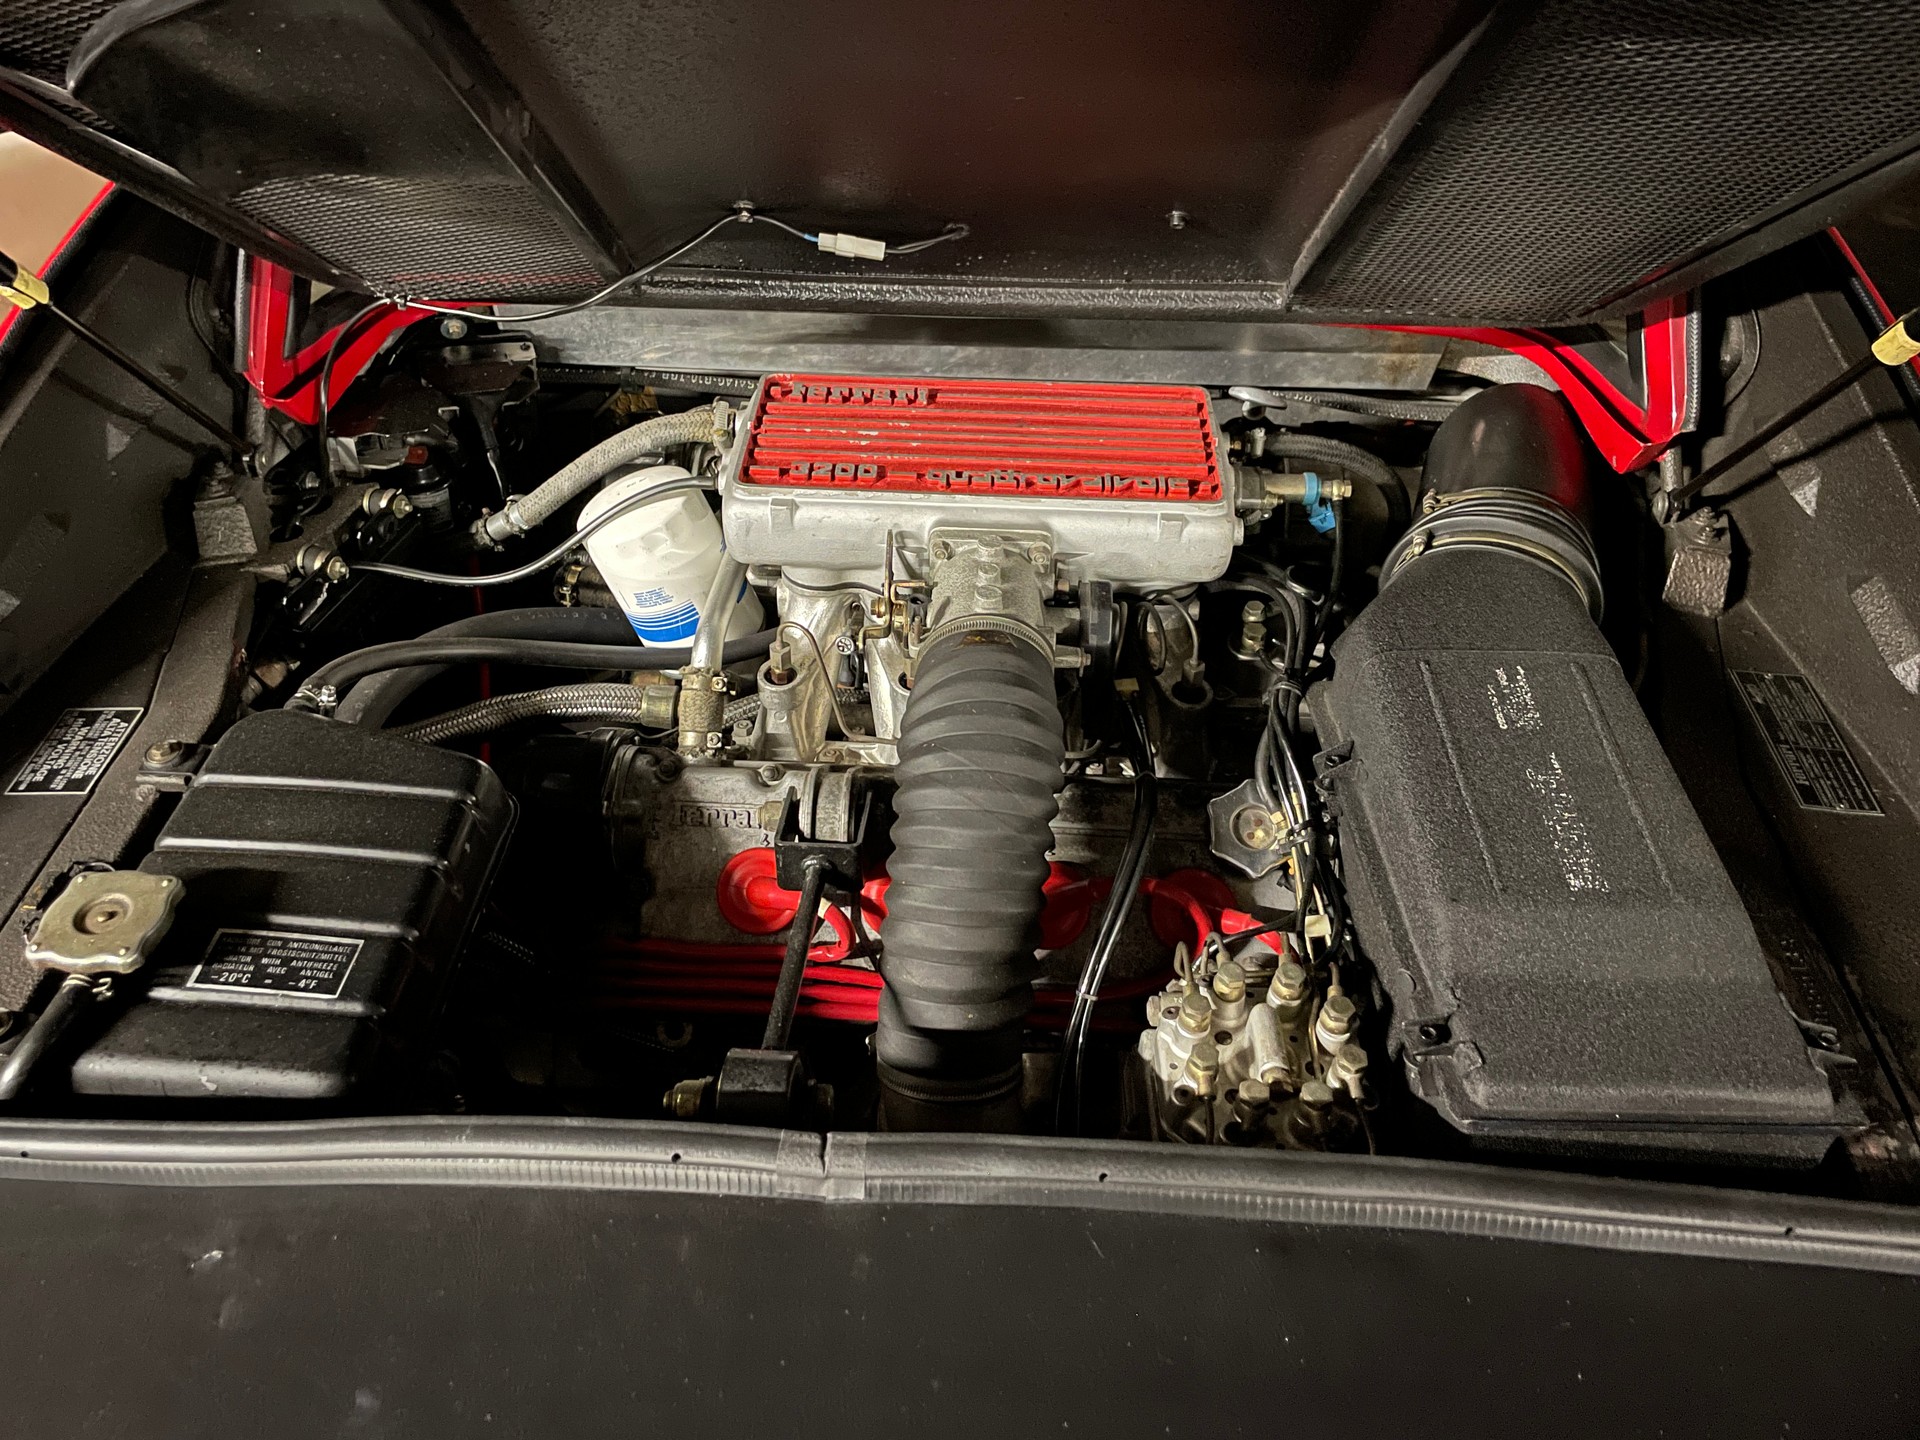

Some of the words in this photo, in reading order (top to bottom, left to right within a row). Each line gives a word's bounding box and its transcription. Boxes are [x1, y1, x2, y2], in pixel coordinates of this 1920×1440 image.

[788, 461, 880, 485] 3200
[926, 469, 1188, 497] quattrovalvole
[61, 718, 86, 740] HIGH
[100, 717, 122, 736] ALTA
[51, 726, 91, 768] WARNING
[71, 738, 106, 779] TENSIONE
[83, 721, 130, 775] ATTENZIONE
[31, 743, 68, 781] VOLTAGE
[266, 939, 283, 947] CON
[287, 941, 353, 953] ANTICONGELANTE
[261, 957, 281, 965] WITH
[290, 959, 339, 971] ANTIFREEZE
[266, 966, 287, 974] AVEC
[299, 969, 333, 979] ANTIGEL
